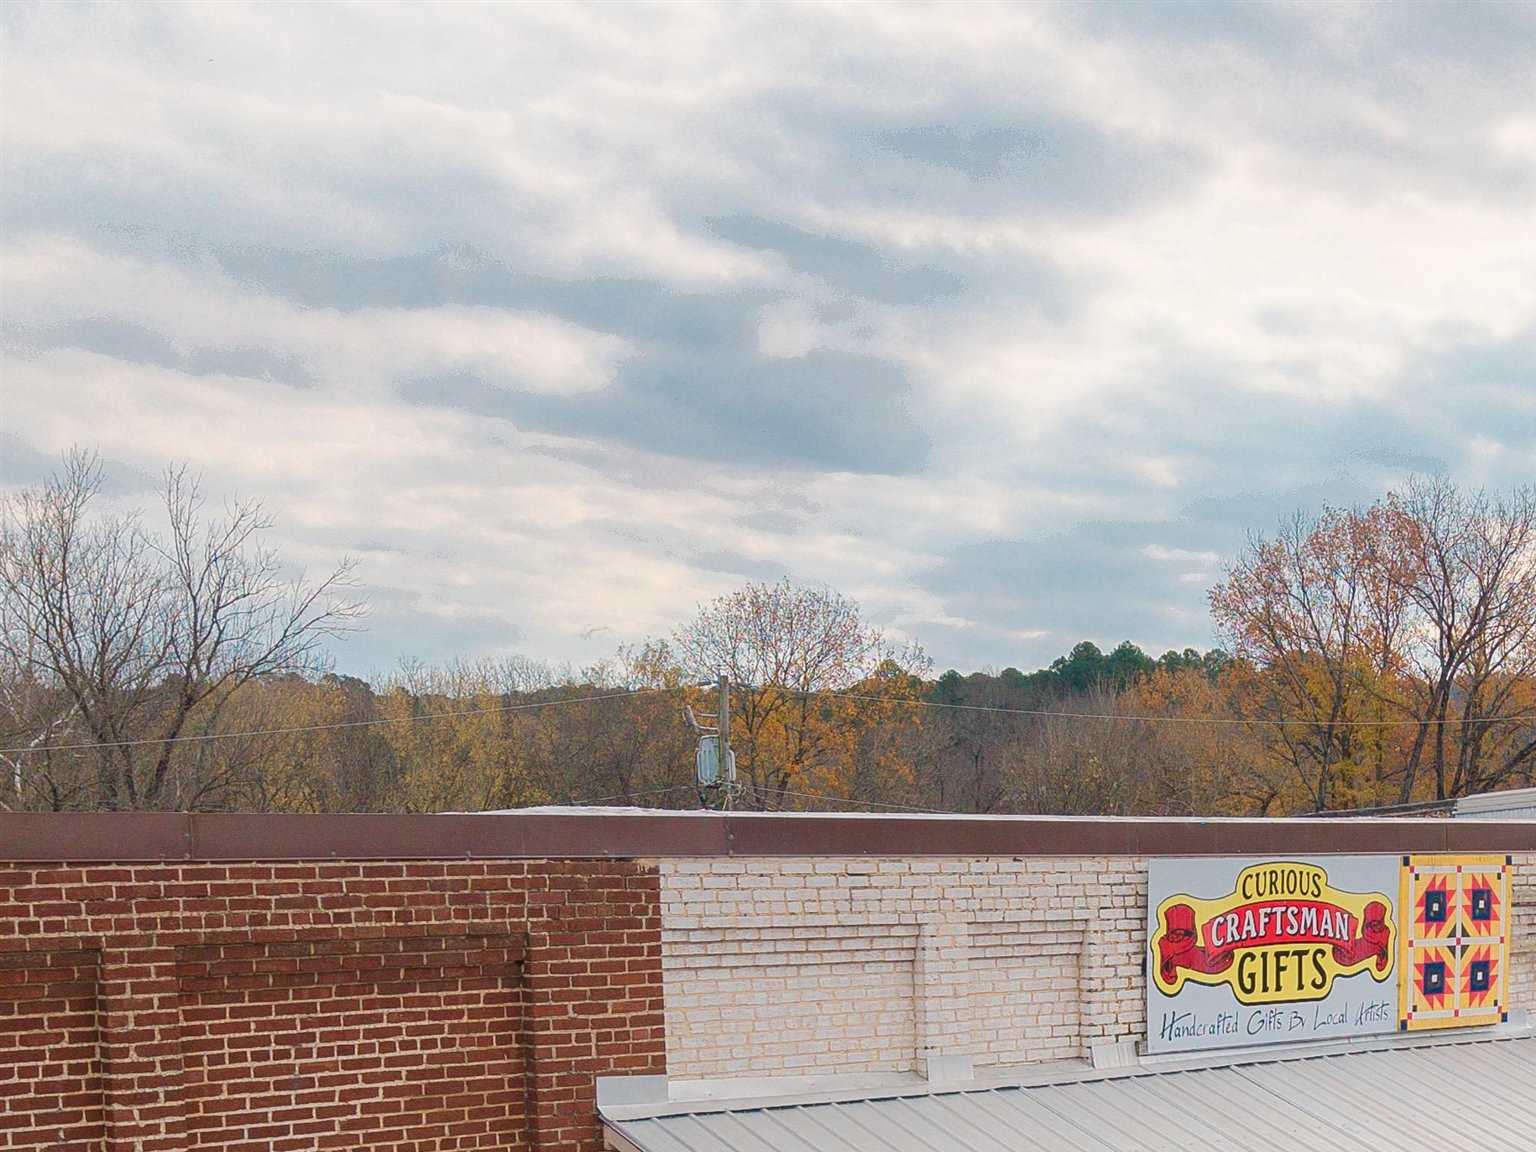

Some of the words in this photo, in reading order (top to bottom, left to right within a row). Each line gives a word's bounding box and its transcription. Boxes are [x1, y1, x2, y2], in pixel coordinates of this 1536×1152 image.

[1242, 869, 1321, 898] CURIOUS
[1211, 906, 1348, 946] CRAFTSMAN
[1237, 949, 1326, 993] GIFTS
[1160, 1011, 1238, 1041] Handcrafted
[1247, 1009, 1283, 1035] Gifts
[1313, 1004, 1348, 1031] Local
[1355, 1002, 1390, 1025] Artists
